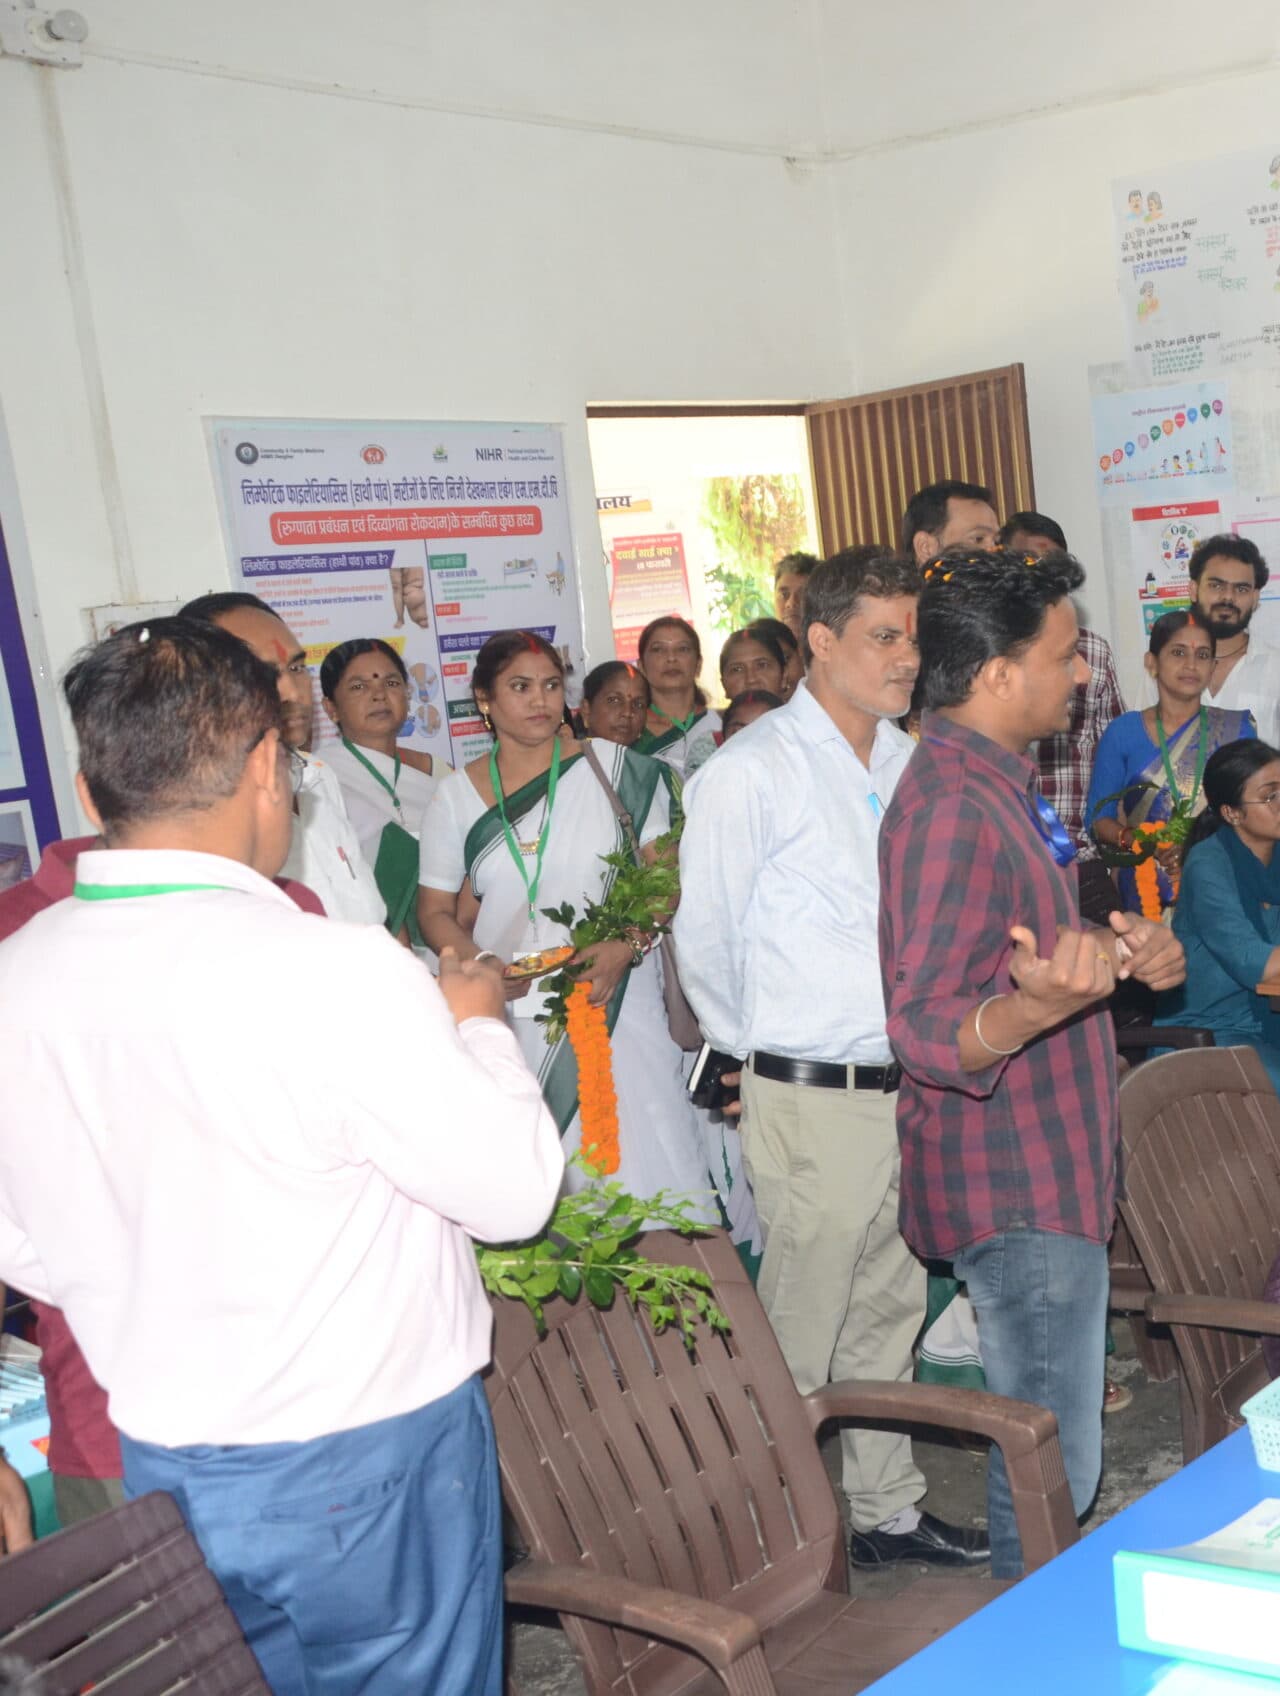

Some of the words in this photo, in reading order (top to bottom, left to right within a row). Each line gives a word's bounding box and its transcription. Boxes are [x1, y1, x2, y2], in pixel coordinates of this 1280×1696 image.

[475, 448, 503, 462] NIHR
[241, 479, 285, 504] लिम्फेटिक
[286, 478, 348, 506] फाइलेरियासिस
[350, 478, 373, 506] (हाथी
[419, 476, 428, 499] के
[428, 476, 445, 500] लिए
[446, 475, 466, 500] निजी
[466, 477, 496, 500] देखभाल
[319, 517, 349, 535] प्रबंधन
[352, 517, 366, 533] एवं
[367, 514, 408, 533] दिव्यांगता
[462, 512, 497, 530] सम्बंधित
[499, 514, 515, 532] कुछ
[516, 513, 535, 528] तथ्य
